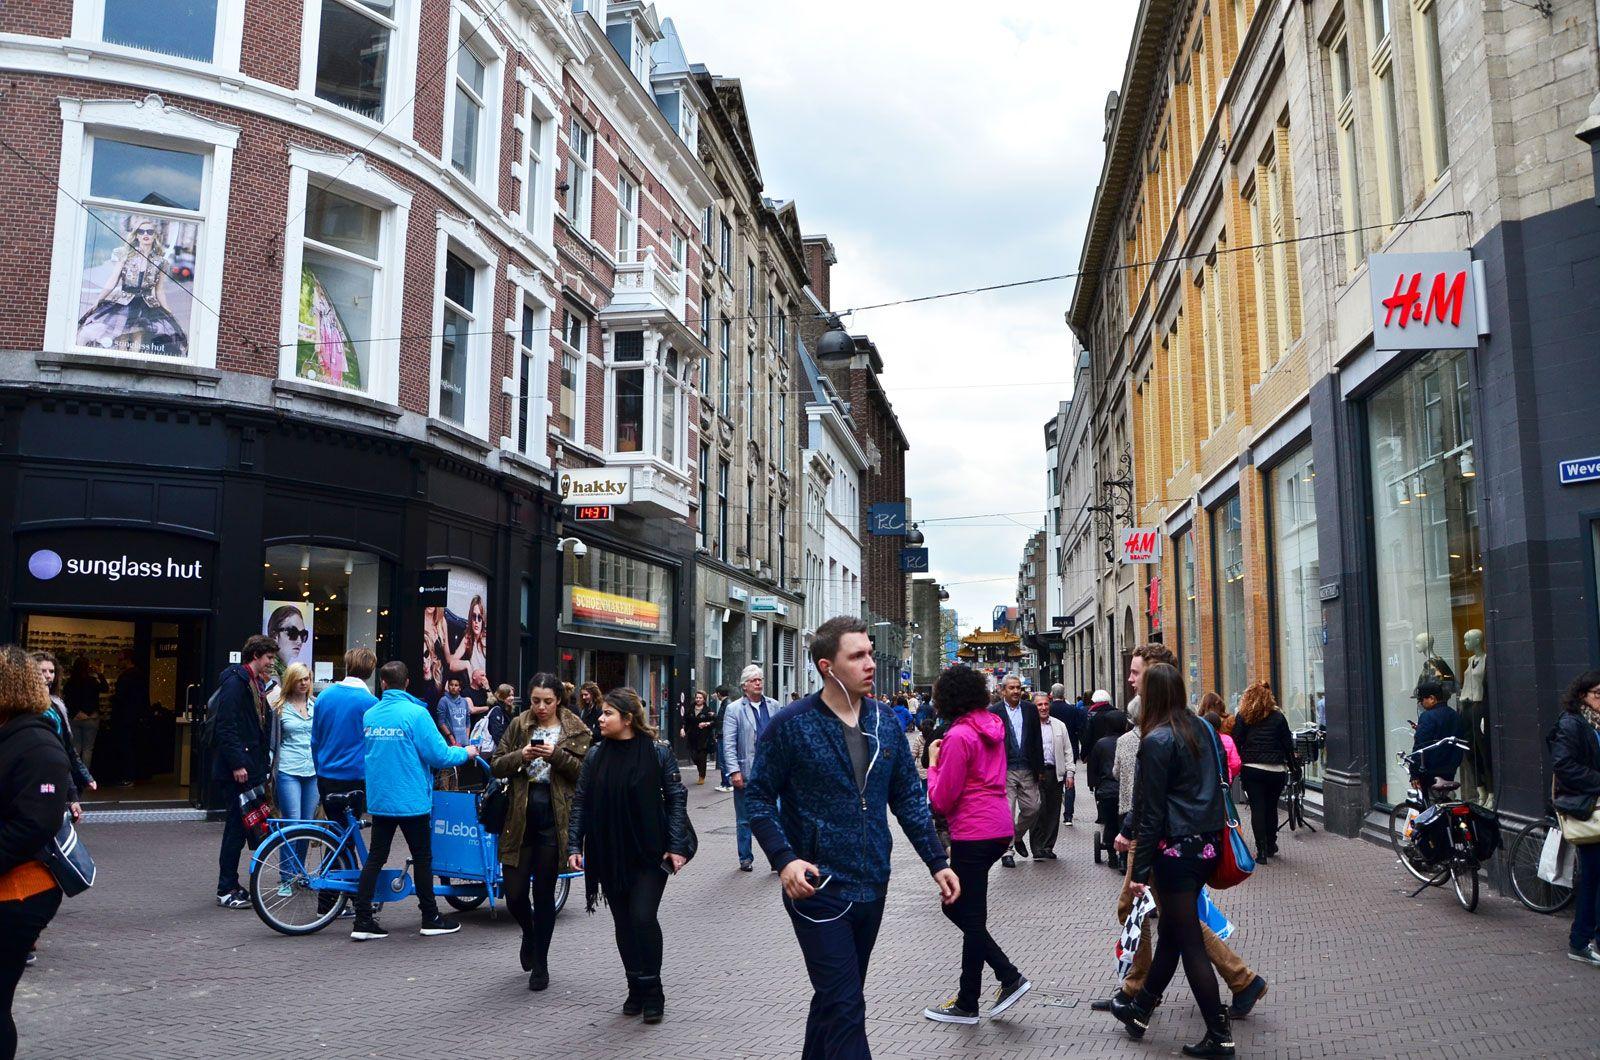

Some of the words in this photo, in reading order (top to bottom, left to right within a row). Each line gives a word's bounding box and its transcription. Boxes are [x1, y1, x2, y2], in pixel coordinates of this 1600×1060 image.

[1382, 270, 1467, 329] H&M
[151, 343, 165, 352] hut
[572, 480, 628, 494] hakky
[580, 507, 608, 519] 14:37
[1125, 532, 1157, 554] H&M
[67, 555, 162, 581] sunglass
[167, 557, 203, 579] hut
[370, 726, 405, 737] Lebara
